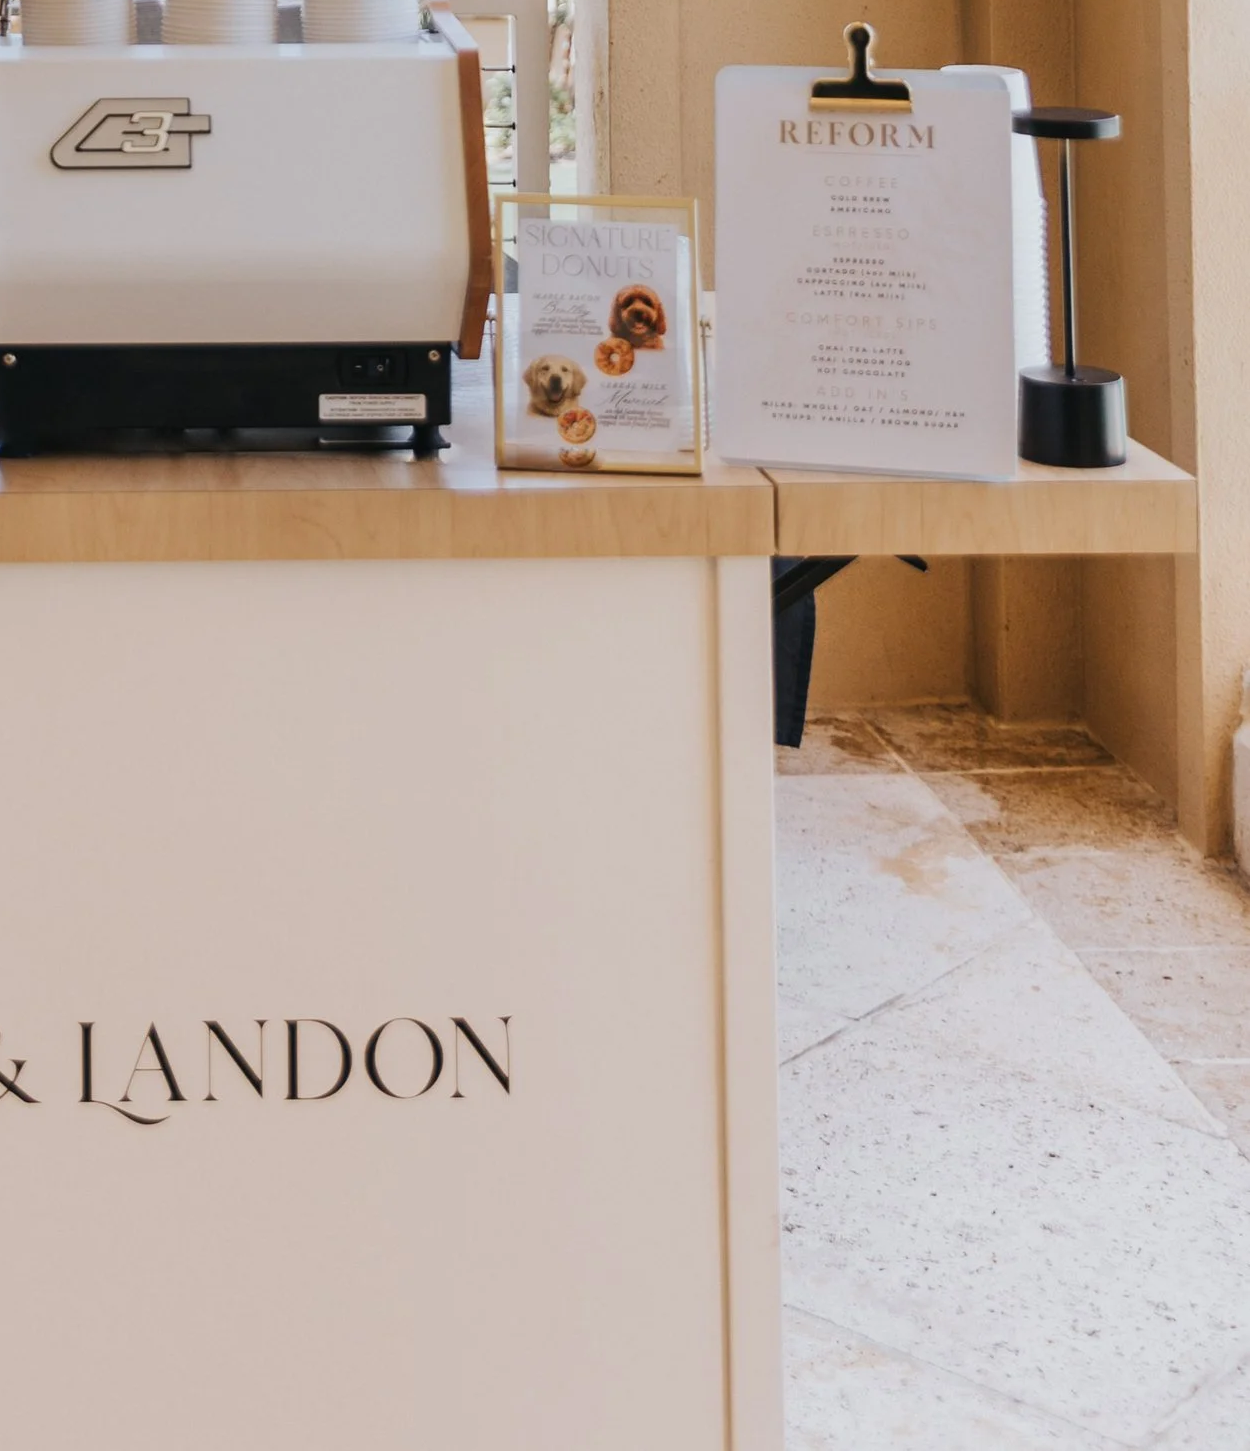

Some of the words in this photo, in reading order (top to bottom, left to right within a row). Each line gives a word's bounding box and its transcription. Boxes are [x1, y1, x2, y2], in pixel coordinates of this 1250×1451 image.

[778, 119, 936, 150] REFORM
[823, 175, 899, 189] COFFEE
[830, 194, 858, 202] COLD
[830, 206, 891, 214] AMERICANO
[524, 224, 671, 253] SIGNATURE
[812, 225, 910, 241] ESPRESSO
[541, 253, 654, 280] DONUTS
[833, 257, 885, 265] ESPRESSO
[806, 267, 856, 275] CORTADO
[813, 289, 844, 298] LATTE
[785, 311, 884, 329] COMFORT
[895, 317, 938, 331] SIPS
[816, 385, 855, 399] ADD
[77, 1015, 514, 1126] LANDON
